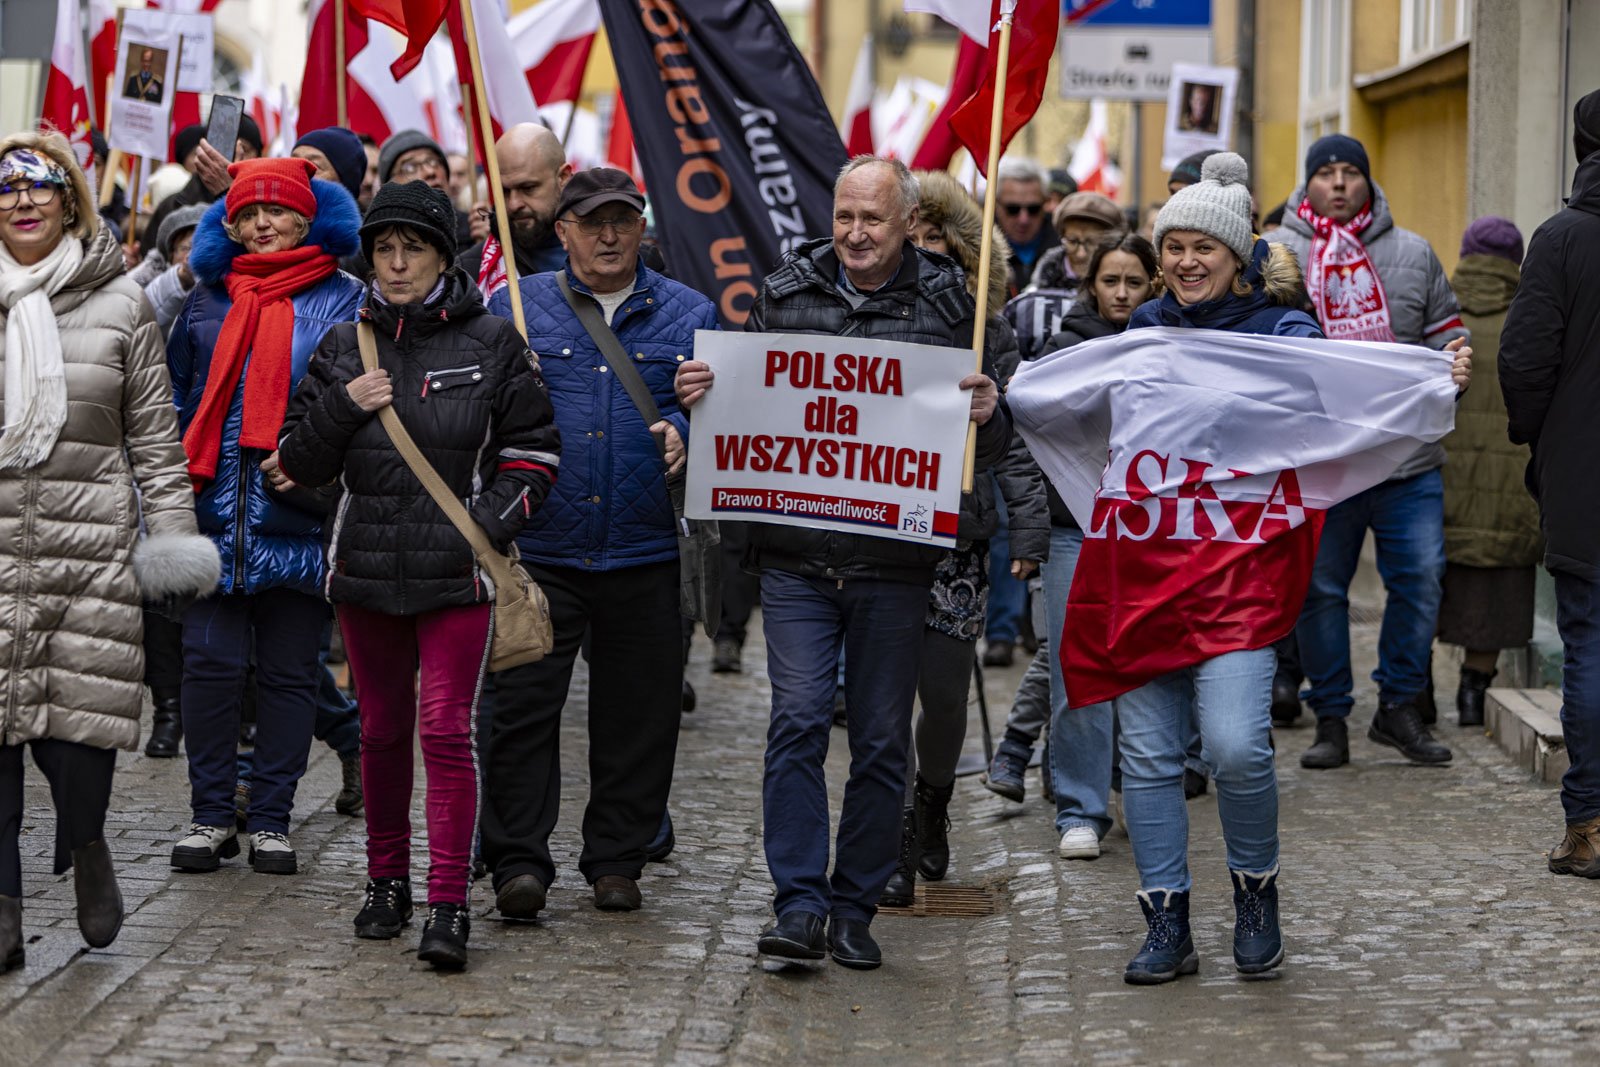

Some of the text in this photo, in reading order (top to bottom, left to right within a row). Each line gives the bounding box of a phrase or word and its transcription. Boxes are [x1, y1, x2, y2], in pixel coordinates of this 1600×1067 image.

[1329, 315, 1385, 333] POLSKA
[764, 350, 903, 396] POLSKA
[804, 395, 858, 435] dla
[714, 434, 941, 491] WSZYSTKICH
[718, 491, 888, 522] Prawo i Sprawiedliwość
[902, 517, 929, 534] PiS
